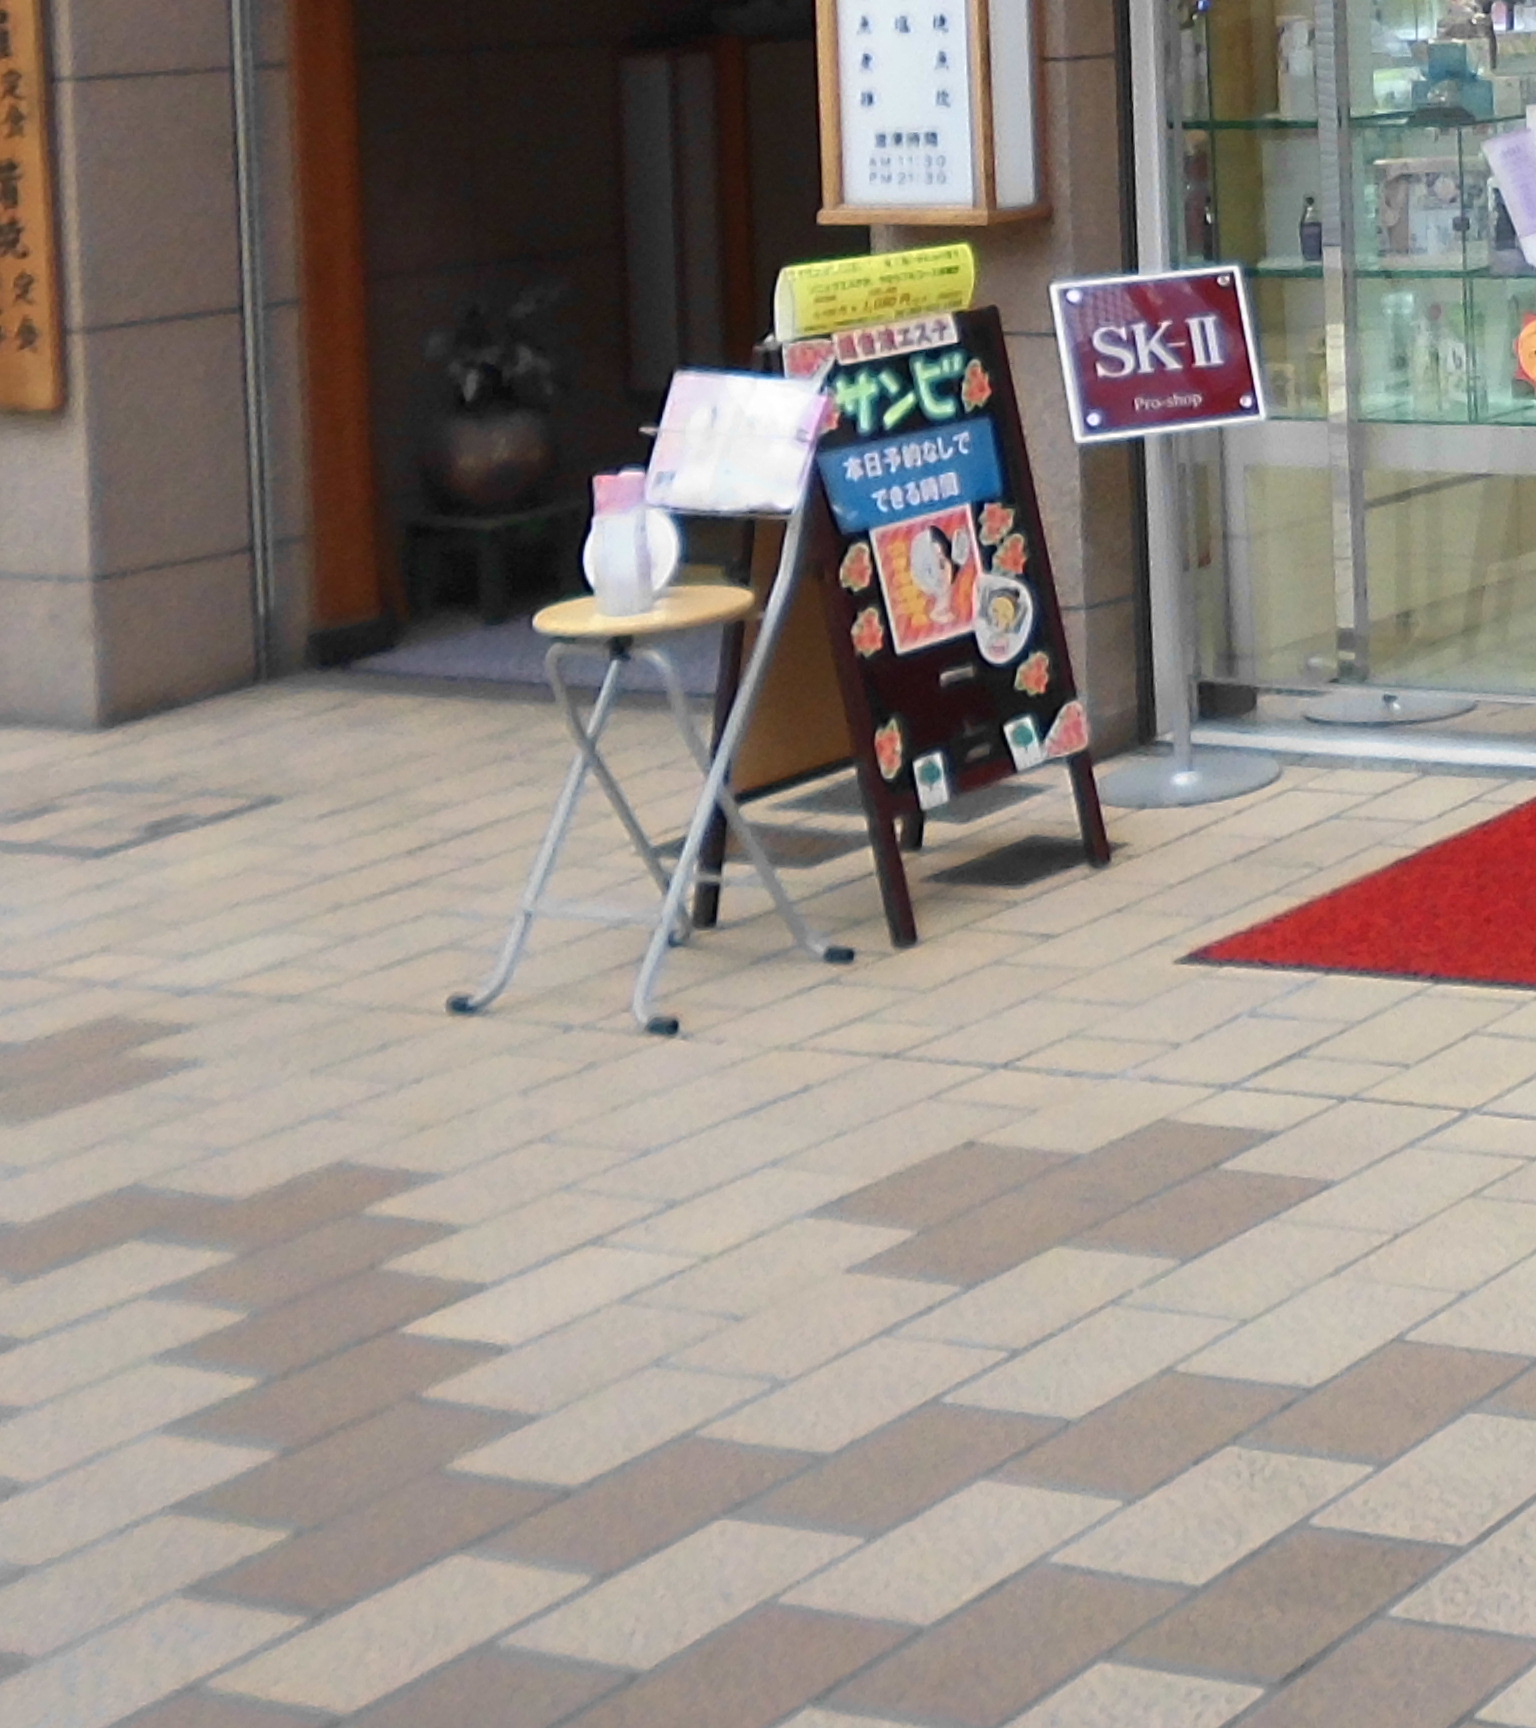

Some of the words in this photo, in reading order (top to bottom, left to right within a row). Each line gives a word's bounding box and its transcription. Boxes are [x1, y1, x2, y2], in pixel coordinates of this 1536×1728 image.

[1091, 314, 1225, 380] SK-II
[835, 349, 967, 436] サンビ
[843, 431, 971, 482] 本日予約なしで
